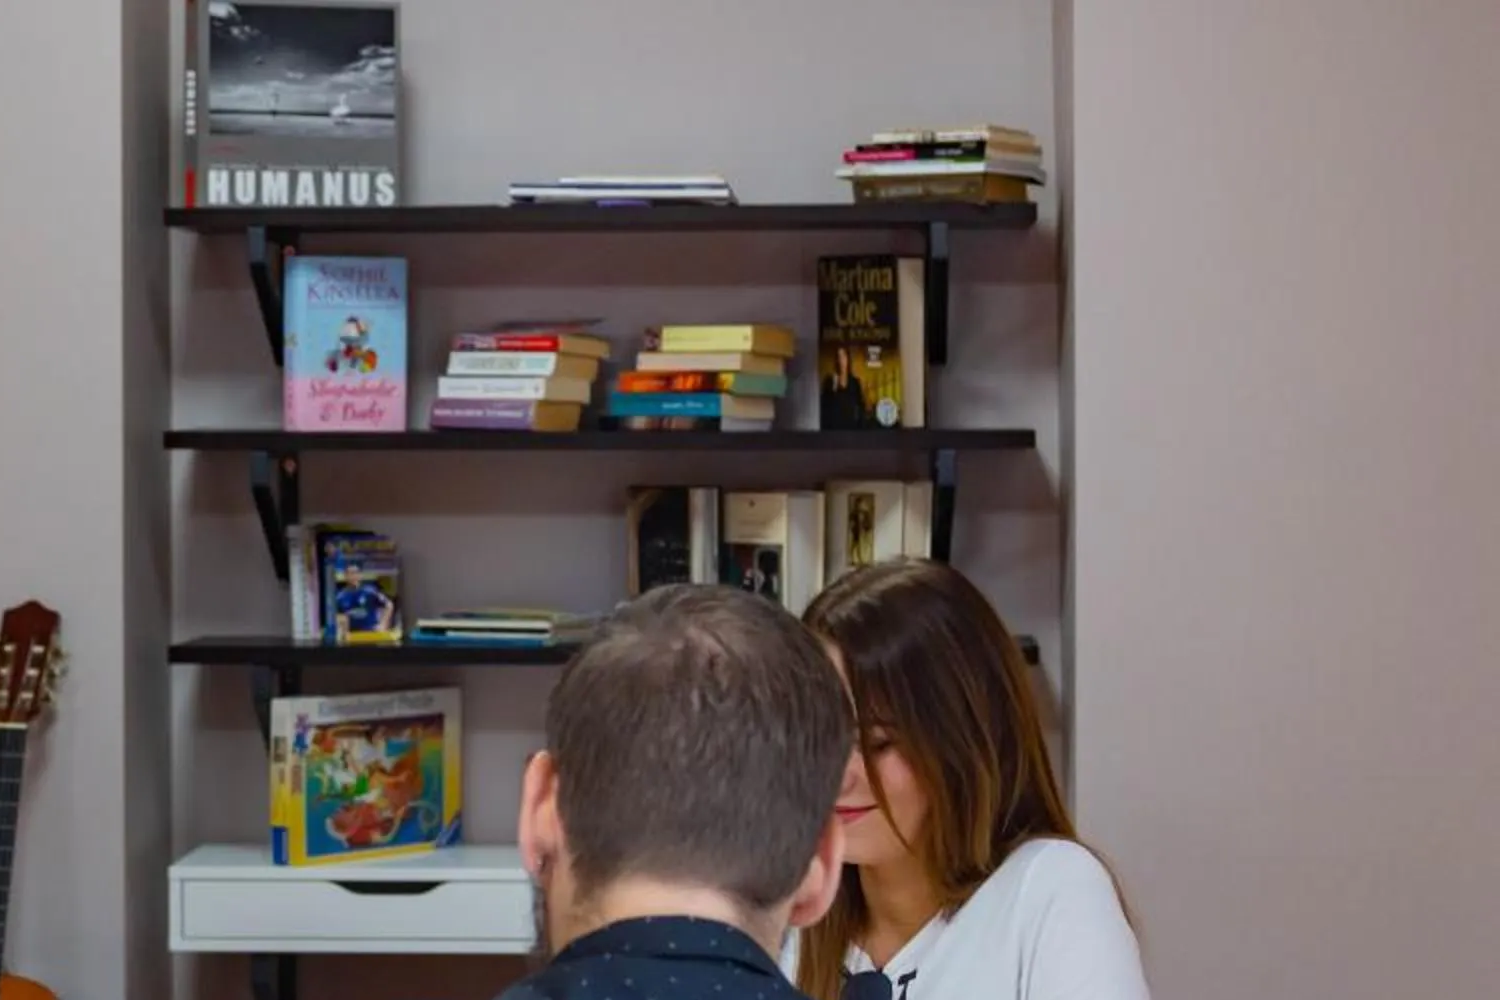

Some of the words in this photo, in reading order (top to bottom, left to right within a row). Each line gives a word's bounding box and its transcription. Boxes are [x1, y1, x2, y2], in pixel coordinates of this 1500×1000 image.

[208, 169, 395, 207] HUMANUS
[819, 260, 893, 293] Martina
[834, 290, 877, 327] Cole
